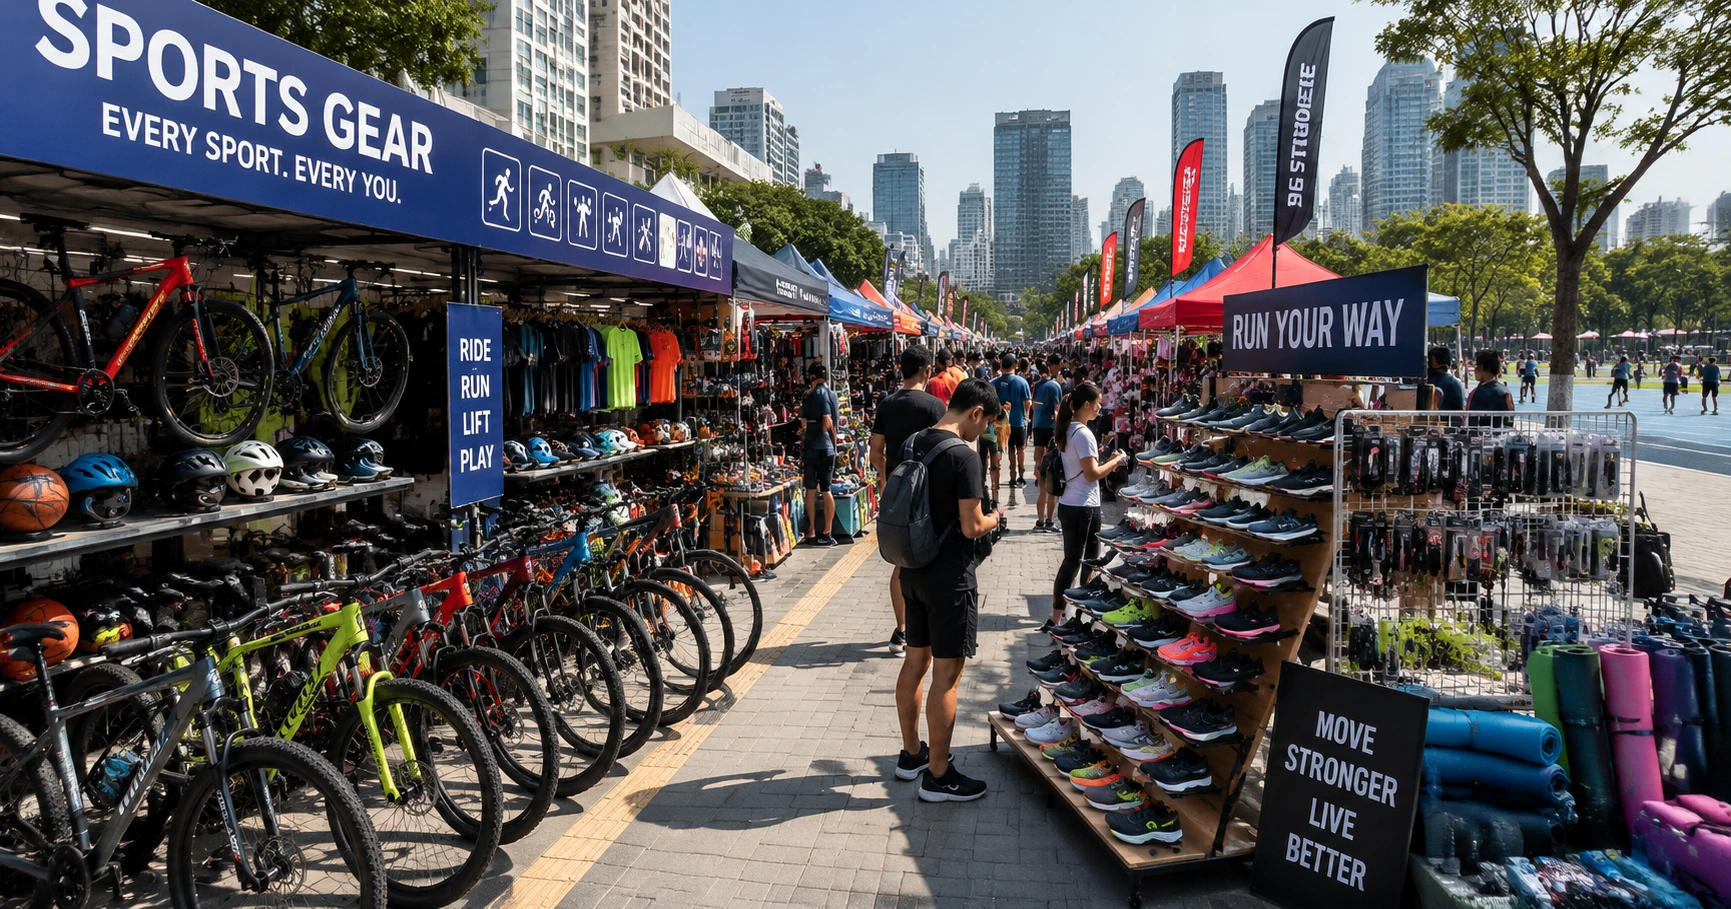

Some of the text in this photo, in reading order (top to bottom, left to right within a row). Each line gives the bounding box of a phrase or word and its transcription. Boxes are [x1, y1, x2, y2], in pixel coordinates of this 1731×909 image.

[35, 0, 432, 174] SPORTS GEAR
[103, 102, 401, 204] EVERY SPORT. EVERY YOU.
[1232, 298, 1404, 349] RUN YOUR WAY
[460, 338, 492, 362] RIDE
[461, 374, 490, 399] RUN
[463, 410, 491, 436] LIFT
[460, 444, 494, 473] PLAY
[1315, 711, 1377, 755] MOVE
[1285, 744, 1398, 807] STRONGER
[1309, 798, 1357, 840] LIVE
[1286, 833, 1366, 891] BETTER
